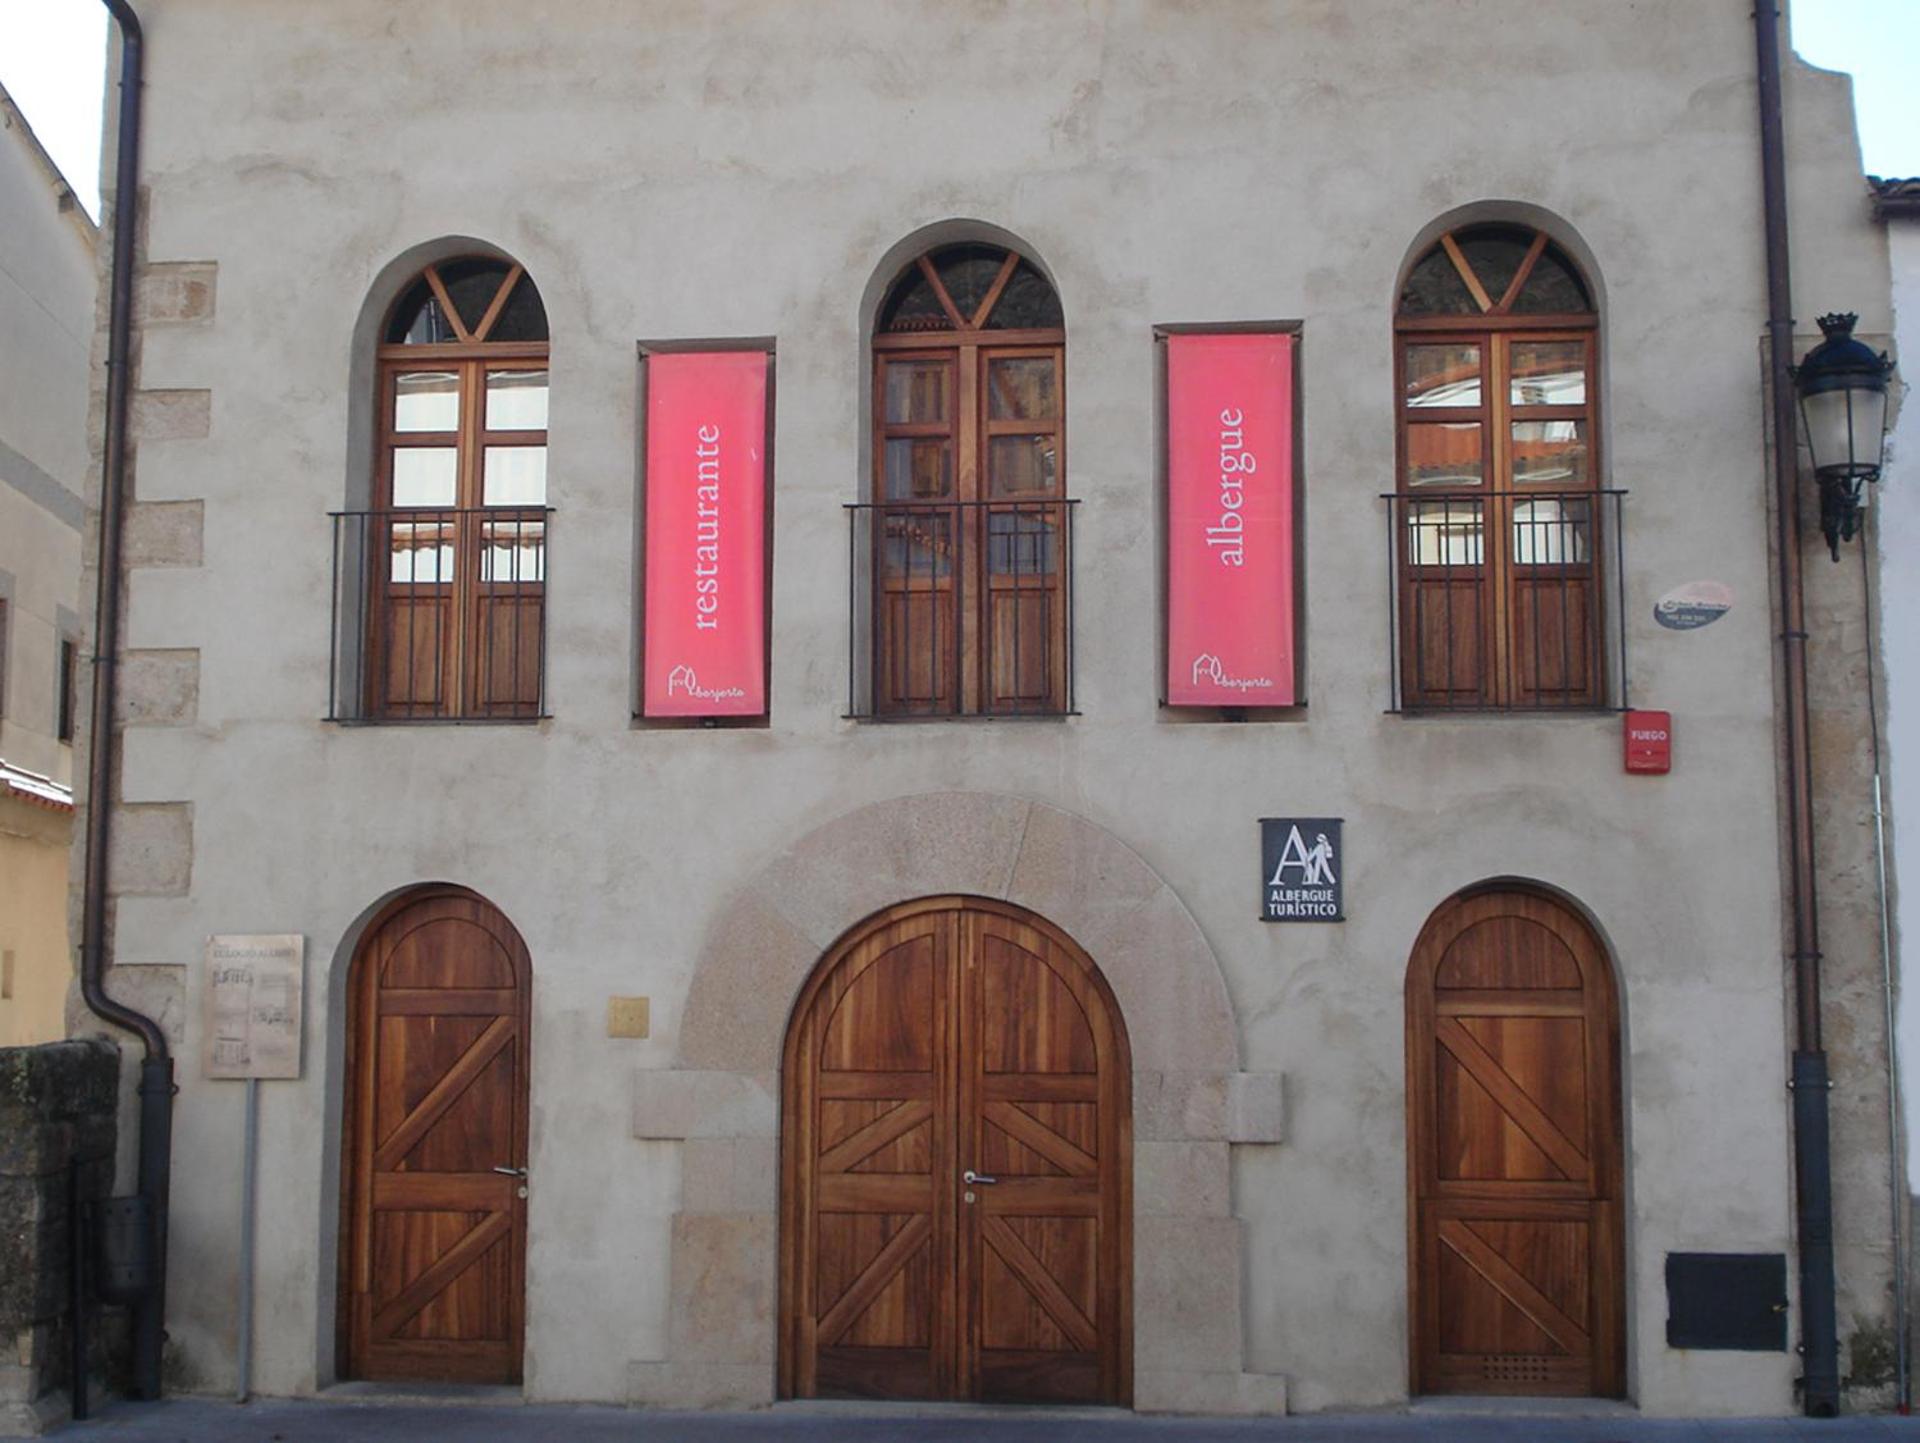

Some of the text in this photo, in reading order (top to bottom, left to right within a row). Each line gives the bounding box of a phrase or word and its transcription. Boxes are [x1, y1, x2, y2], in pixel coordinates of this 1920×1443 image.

[1206, 407, 1257, 567] albergue
[695, 424, 720, 630] restaurante
[1631, 729, 1668, 742] FUEGO
[1271, 889, 1335, 902] ALBERGUE
[1269, 901, 1338, 916] TURÍSTICO
